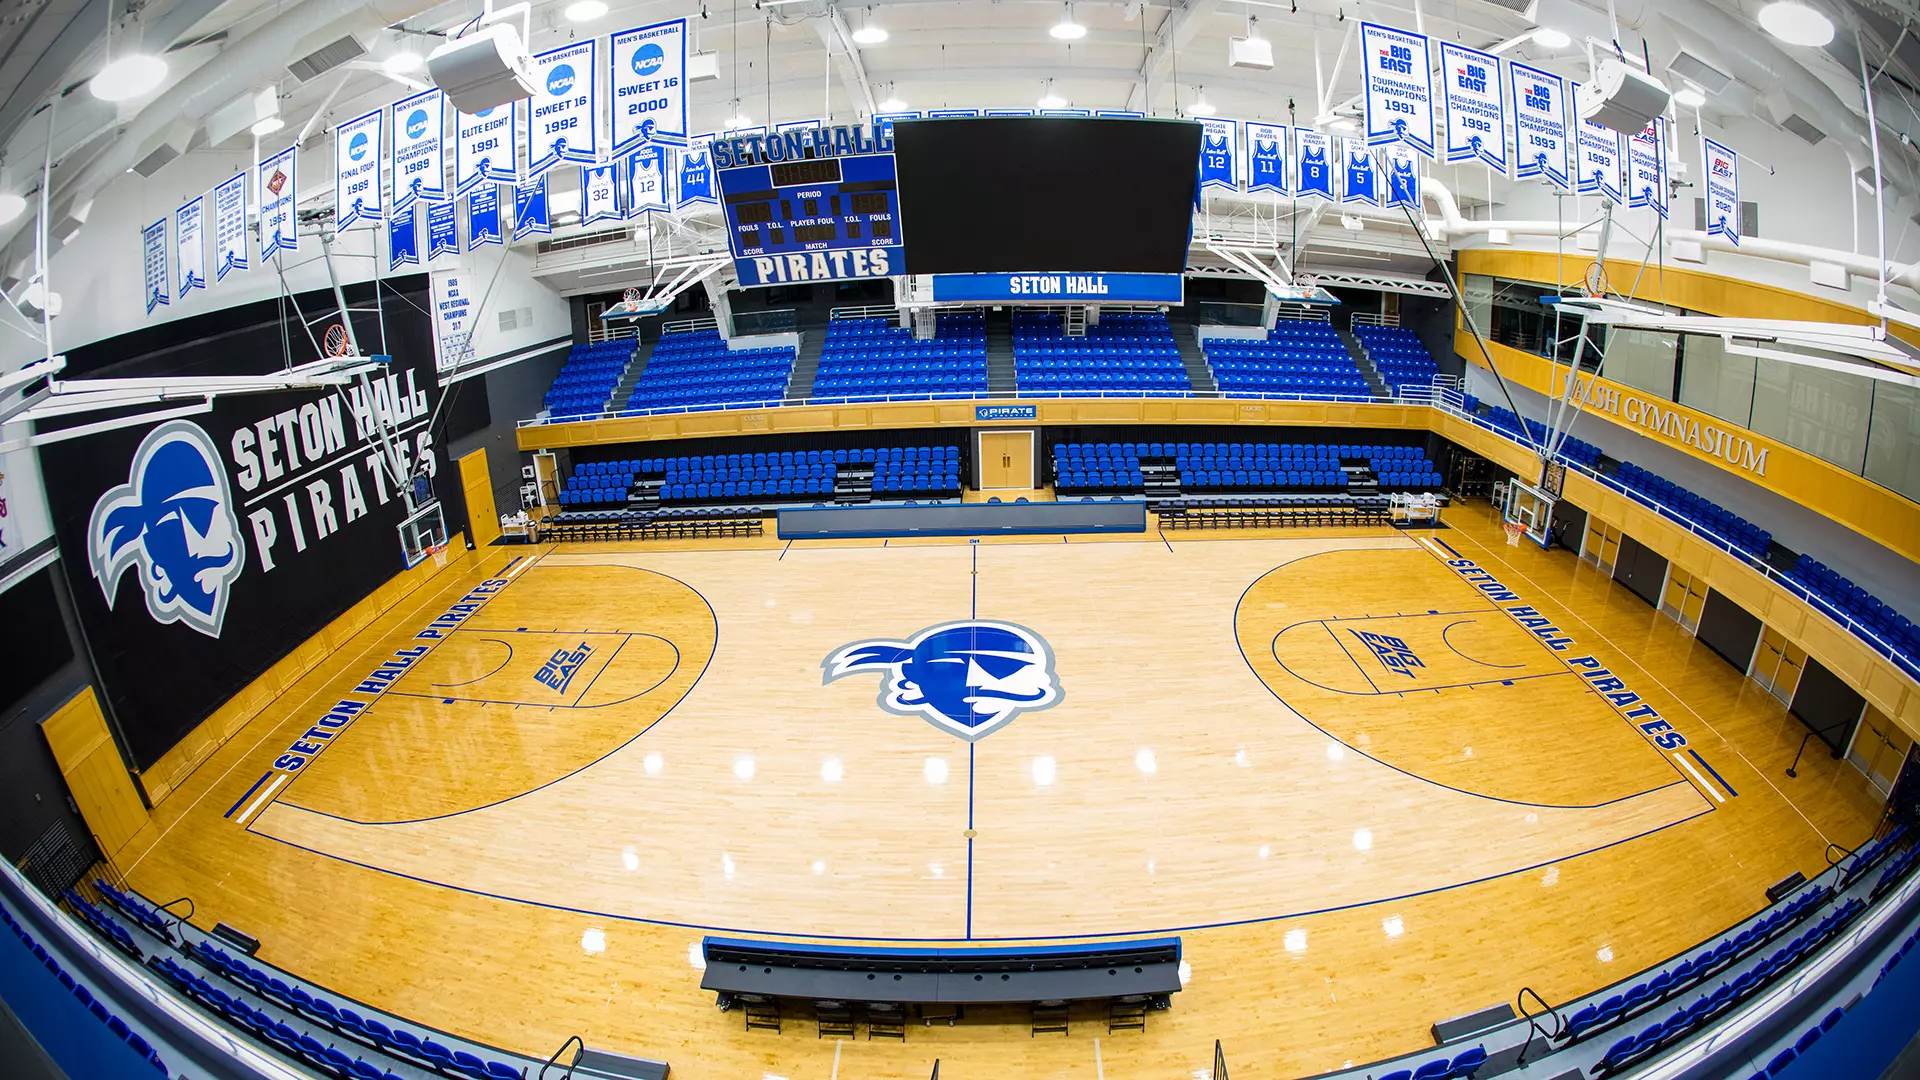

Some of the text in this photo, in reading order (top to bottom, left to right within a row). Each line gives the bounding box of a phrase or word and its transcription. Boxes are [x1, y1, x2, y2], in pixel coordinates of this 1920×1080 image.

[617, 26, 679, 45] MEN'S BASKETBALL
[1367, 29, 1422, 48] MEN'S BASKETBALL
[536, 46, 590, 66] EN'S BASKETBALL
[1390, 44, 1412, 60] BIG
[1446, 48, 1496, 67] MEN'S BASKETBALL
[634, 56, 664, 71] NCAA
[1380, 56, 1412, 74] EAST
[1457, 64, 1486, 80] THE BIG
[548, 76, 576, 92] NCAA
[618, 77, 678, 97] SWEET 16
[1372, 76, 1426, 93] TOURNAMENT
[1458, 75, 1487, 93] EAST
[1531, 74, 1558, 87] BASKETBALL
[411, 92, 440, 108] BASKETBALL
[1372, 84, 1428, 102] CHAMPIONS
[1533, 84, 1550, 100] BIG
[535, 96, 588, 118] SWEET 16
[628, 98, 668, 115] 2000
[1384, 99, 1416, 116] 1991
[1450, 94, 1499, 112] REGULAR SEASON
[1450, 102, 1500, 120] CHAMPIONS
[1526, 94, 1551, 112] EAST
[462, 116, 509, 138] ELITE EIGHT
[545, 116, 578, 134] 1992
[1462, 116, 1491, 132] 1992
[1519, 113, 1562, 130] REGULAR SEASON
[1520, 120, 1564, 138] CHAMPIONS
[412, 137, 438, 151] REGIONAL
[1256, 132, 1278, 140] DAVIES
[1529, 134, 1556, 150] 1993
[1580, 130, 1616, 148] TOURNAMENT
[472, 138, 500, 154] 1991
[712, 122, 895, 168] SETON HALL
[1578, 138, 1617, 156] CHAMPIONS
[396, 144, 438, 164] CHAMPIONS
[1208, 156, 1225, 168] 12
[1588, 152, 1611, 166] 1993
[341, 160, 375, 180] FINAL FOUR
[404, 158, 430, 175] 1989
[1260, 160, 1275, 174] 11
[1310, 166, 1320, 178] 8
[1632, 156, 1663, 173] CHAMPIOS
[1713, 164, 1733, 178] EAST
[1714, 158, 1729, 170] BIG
[686, 172, 705, 186] 44
[1356, 172, 1364, 184] 5
[1638, 169, 1658, 184] 2016
[347, 180, 369, 196] 1989
[593, 188, 609, 202] 32
[640, 180, 655, 193] 12
[797, 190, 822, 199] PERIOD
[262, 194, 293, 214] CHAMIONS
[1716, 200, 1732, 214] 2020
[766, 222, 784, 230] T.O.L.
[790, 217, 835, 228] PLAYER FOUL
[844, 215, 862, 223] T.O.L.
[869, 213, 892, 222] FOULS
[738, 224, 759, 232] FOULS
[805, 242, 828, 250] MATCH
[872, 238, 894, 246] SCORE
[743, 248, 764, 256] SCORE
[753, 248, 890, 284] PIRATES
[1010, 276, 1108, 294] SETON HALL
[444, 309, 468, 321] CHAMPIONS
[231, 367, 428, 492] SETON HALL
[1624, 396, 1770, 477] GYMNASIUM
[247, 430, 437, 573] PIRATES
[1360, 630, 1416, 679] EAST
[1381, 634, 1426, 669] BIG
[1446, 558, 1689, 752] SETON HALL PIRATES
[533, 648, 572, 686] BIG
[546, 641, 595, 691] EAST
[272, 578, 510, 772] SETON HALL PIRATES
